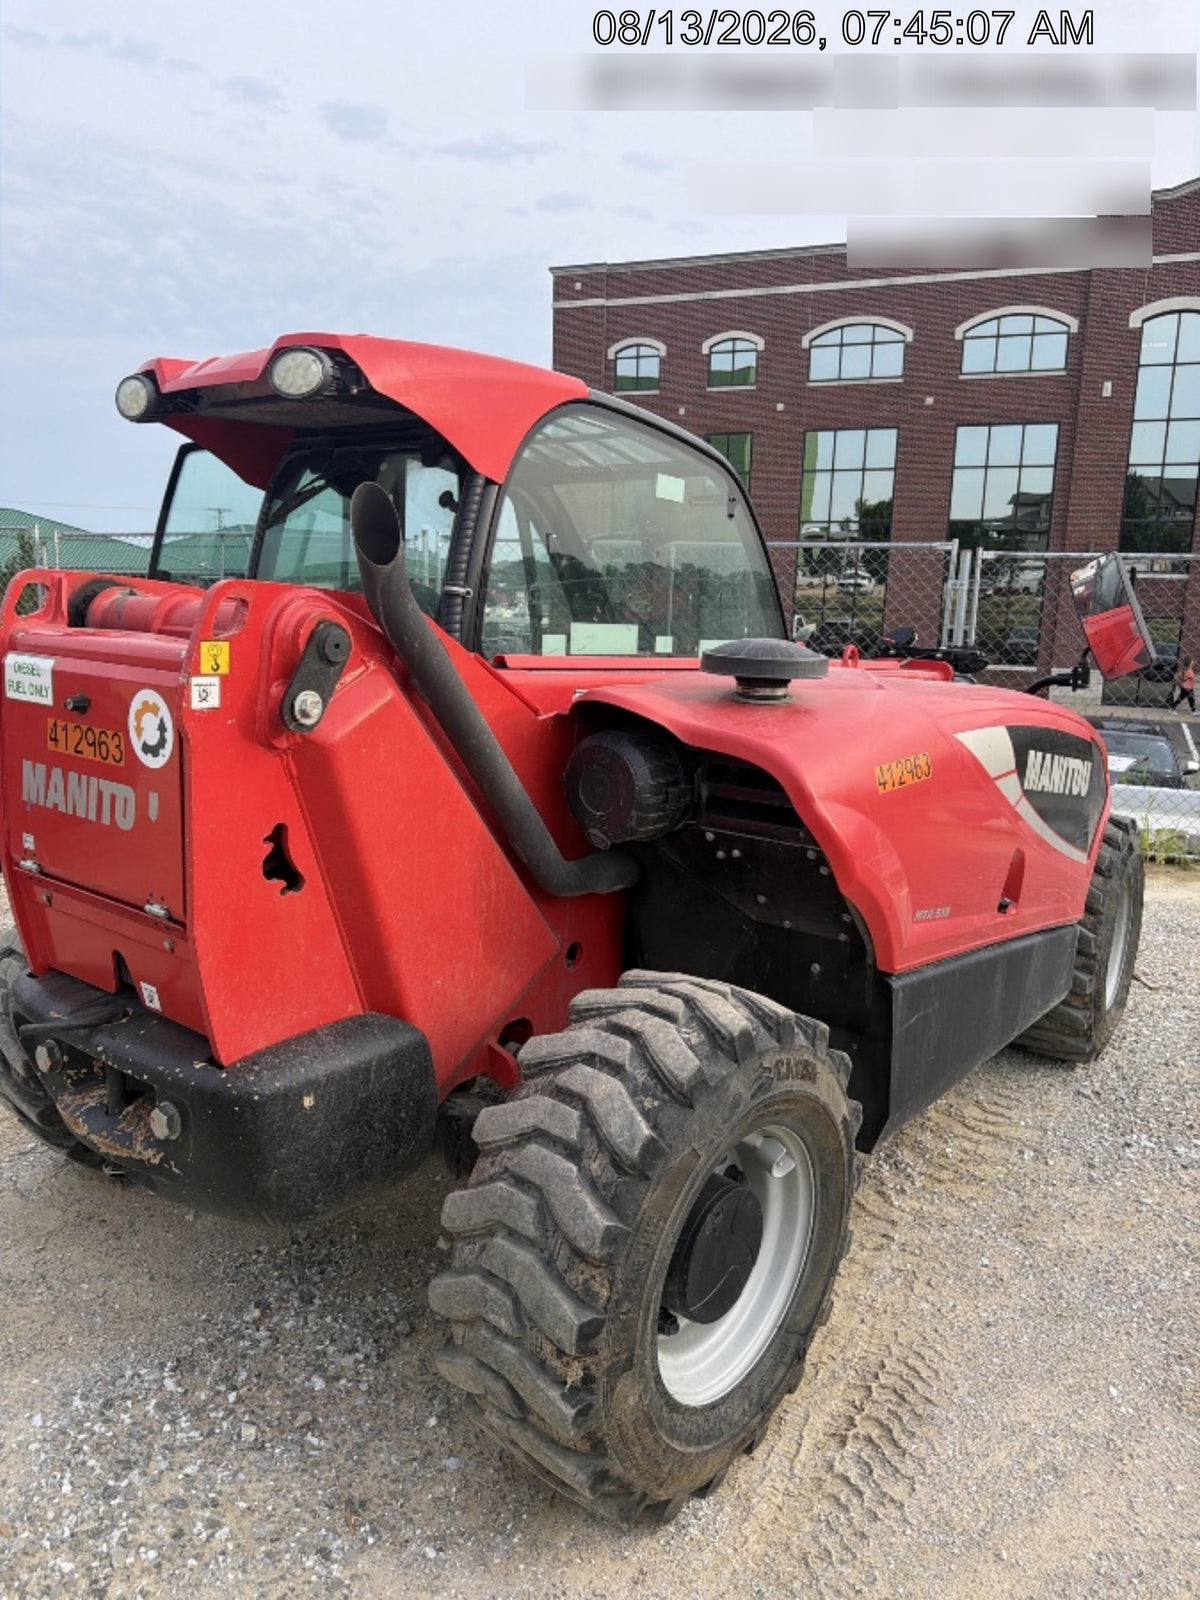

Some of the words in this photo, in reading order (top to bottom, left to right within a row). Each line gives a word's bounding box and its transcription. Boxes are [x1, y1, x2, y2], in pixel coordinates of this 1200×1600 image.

[7, 678, 27, 695] FUEL
[28, 681, 51, 699] ONLY
[13, 660, 41, 678] DIESEL
[48, 718, 124, 764] 412963
[878, 752, 931, 791] 412963
[1023, 749, 1093, 797] MANITOU
